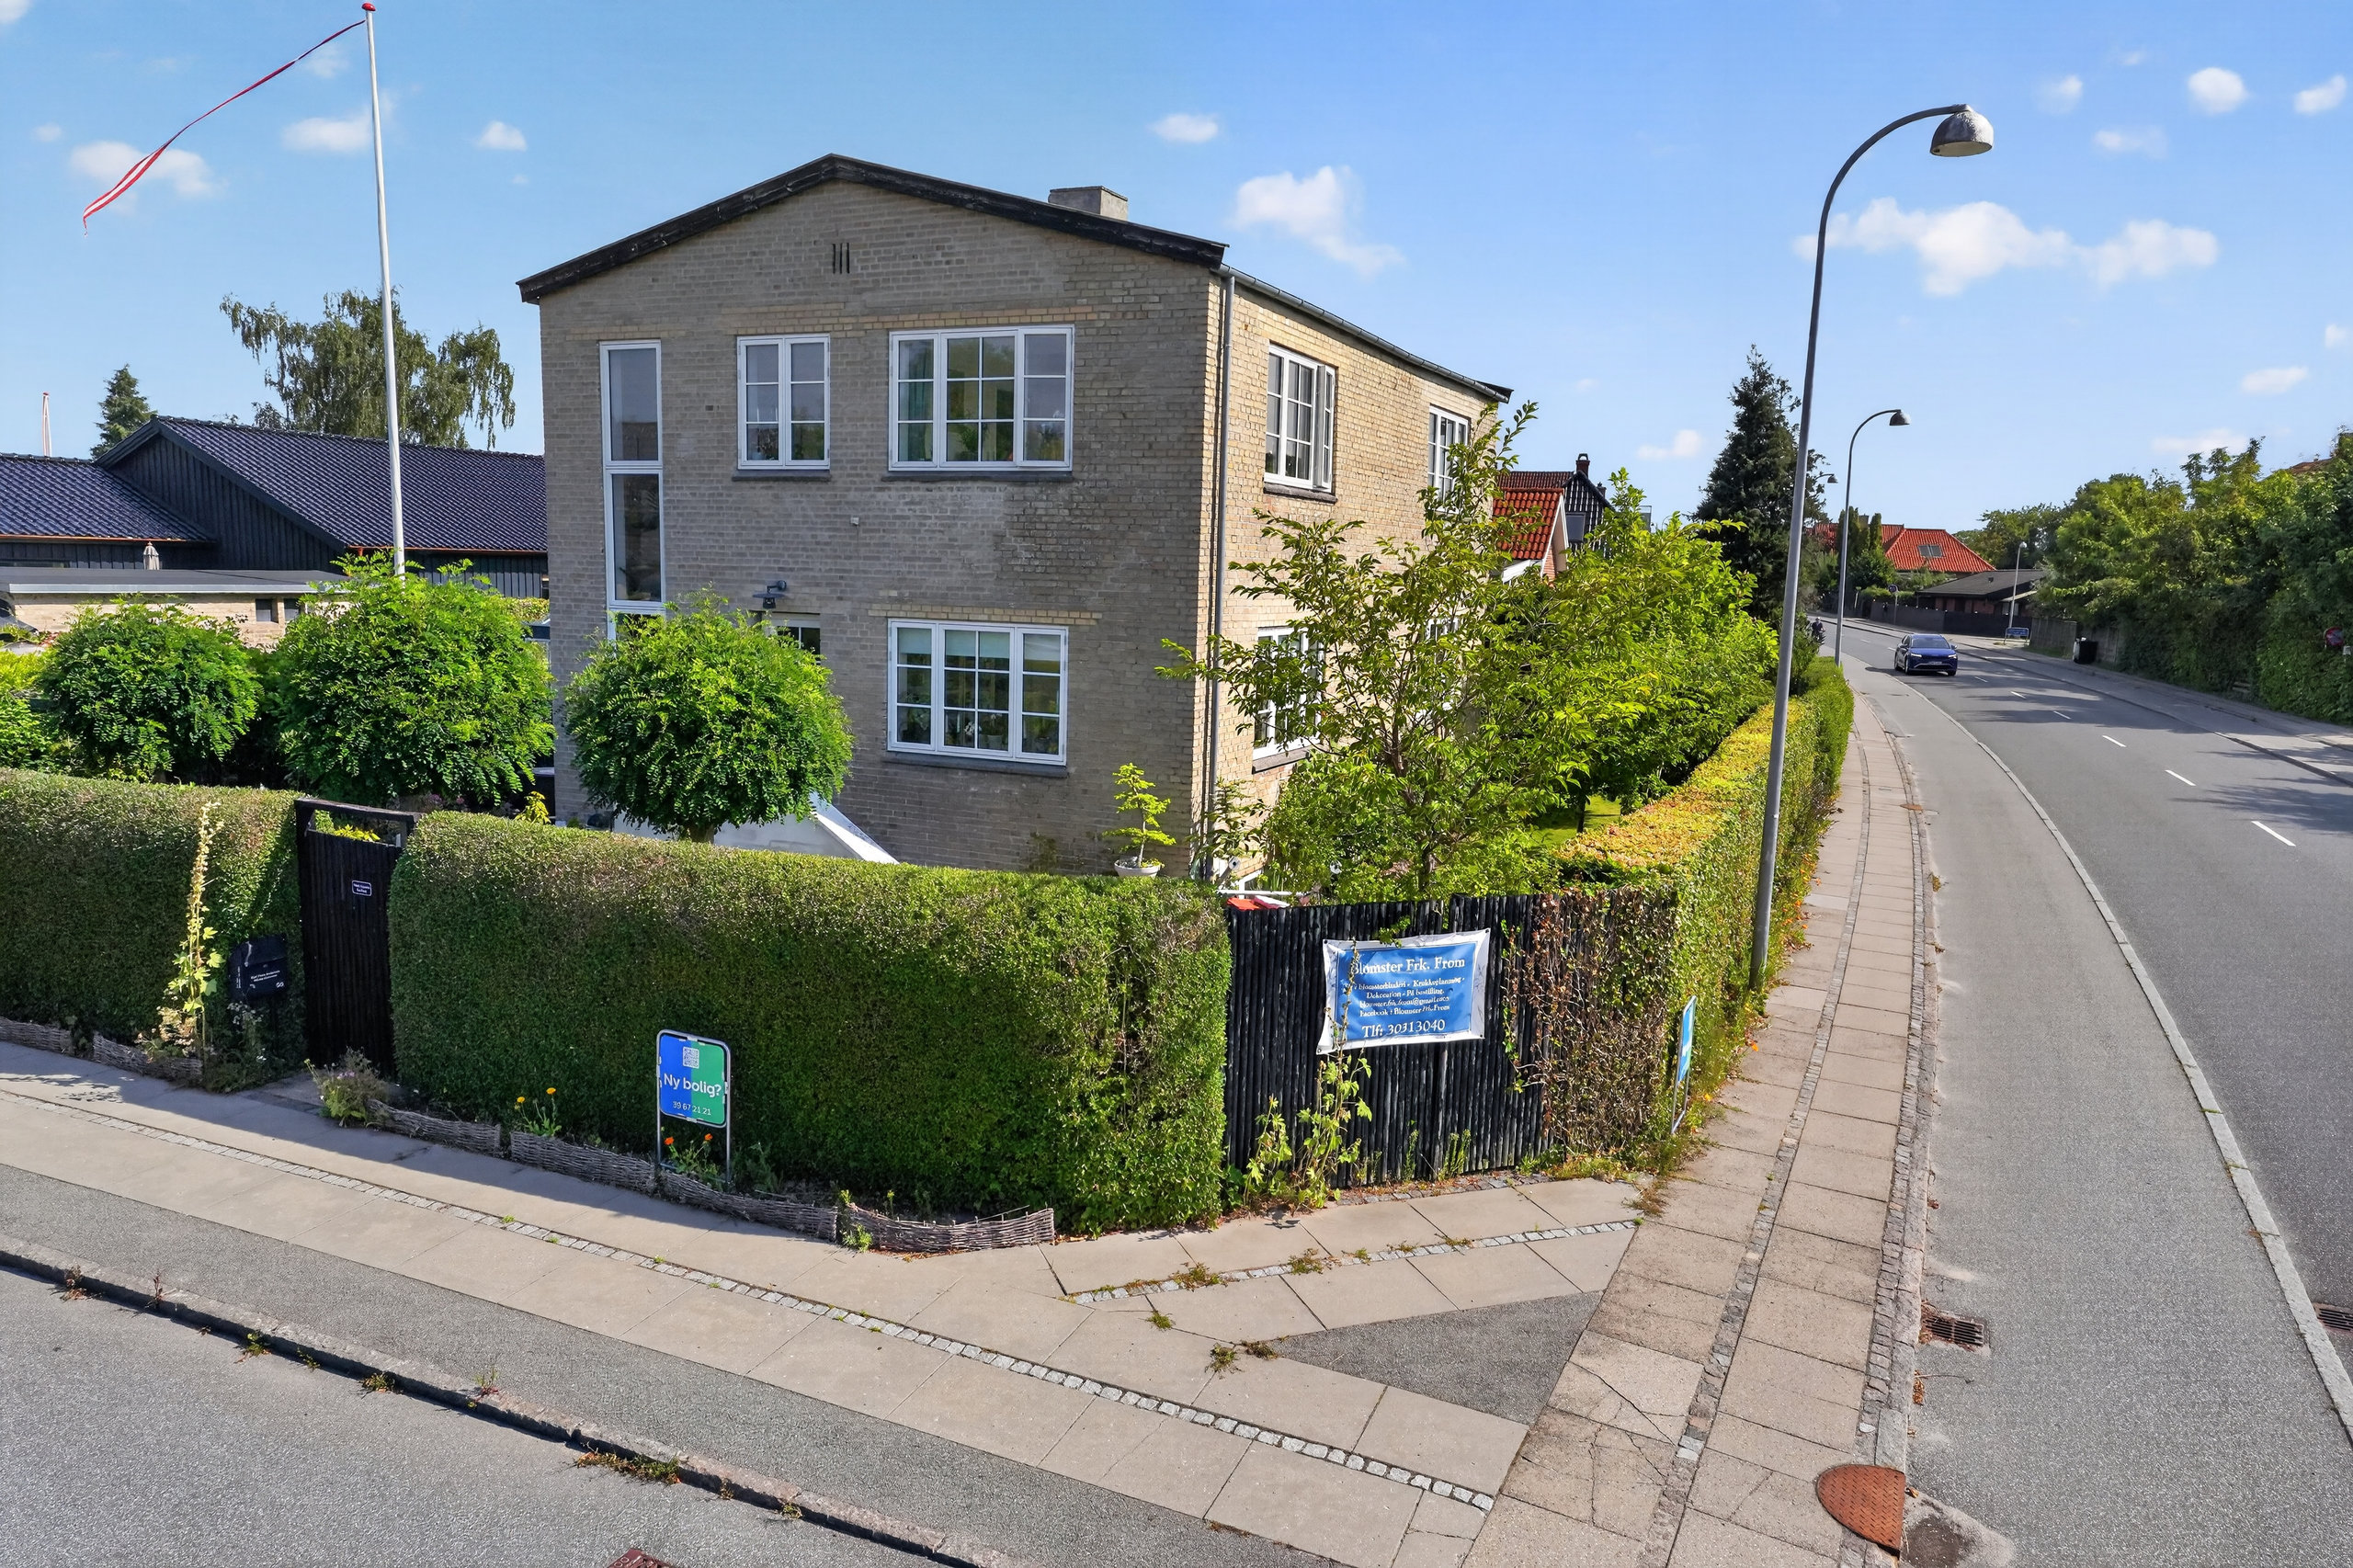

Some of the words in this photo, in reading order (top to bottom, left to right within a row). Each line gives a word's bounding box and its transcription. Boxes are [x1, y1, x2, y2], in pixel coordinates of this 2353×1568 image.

[1405, 958, 1429, 971] Frk.
[1434, 956, 1465, 970] From
[1361, 1024, 1383, 1038] Tlf:
[1387, 1018, 1446, 1035] 30313040
[664, 1073, 681, 1090] Ny
[683, 1077, 722, 1097] bolig?
[673, 1101, 682, 1109] 39
[702, 1108, 711, 1116] 21
